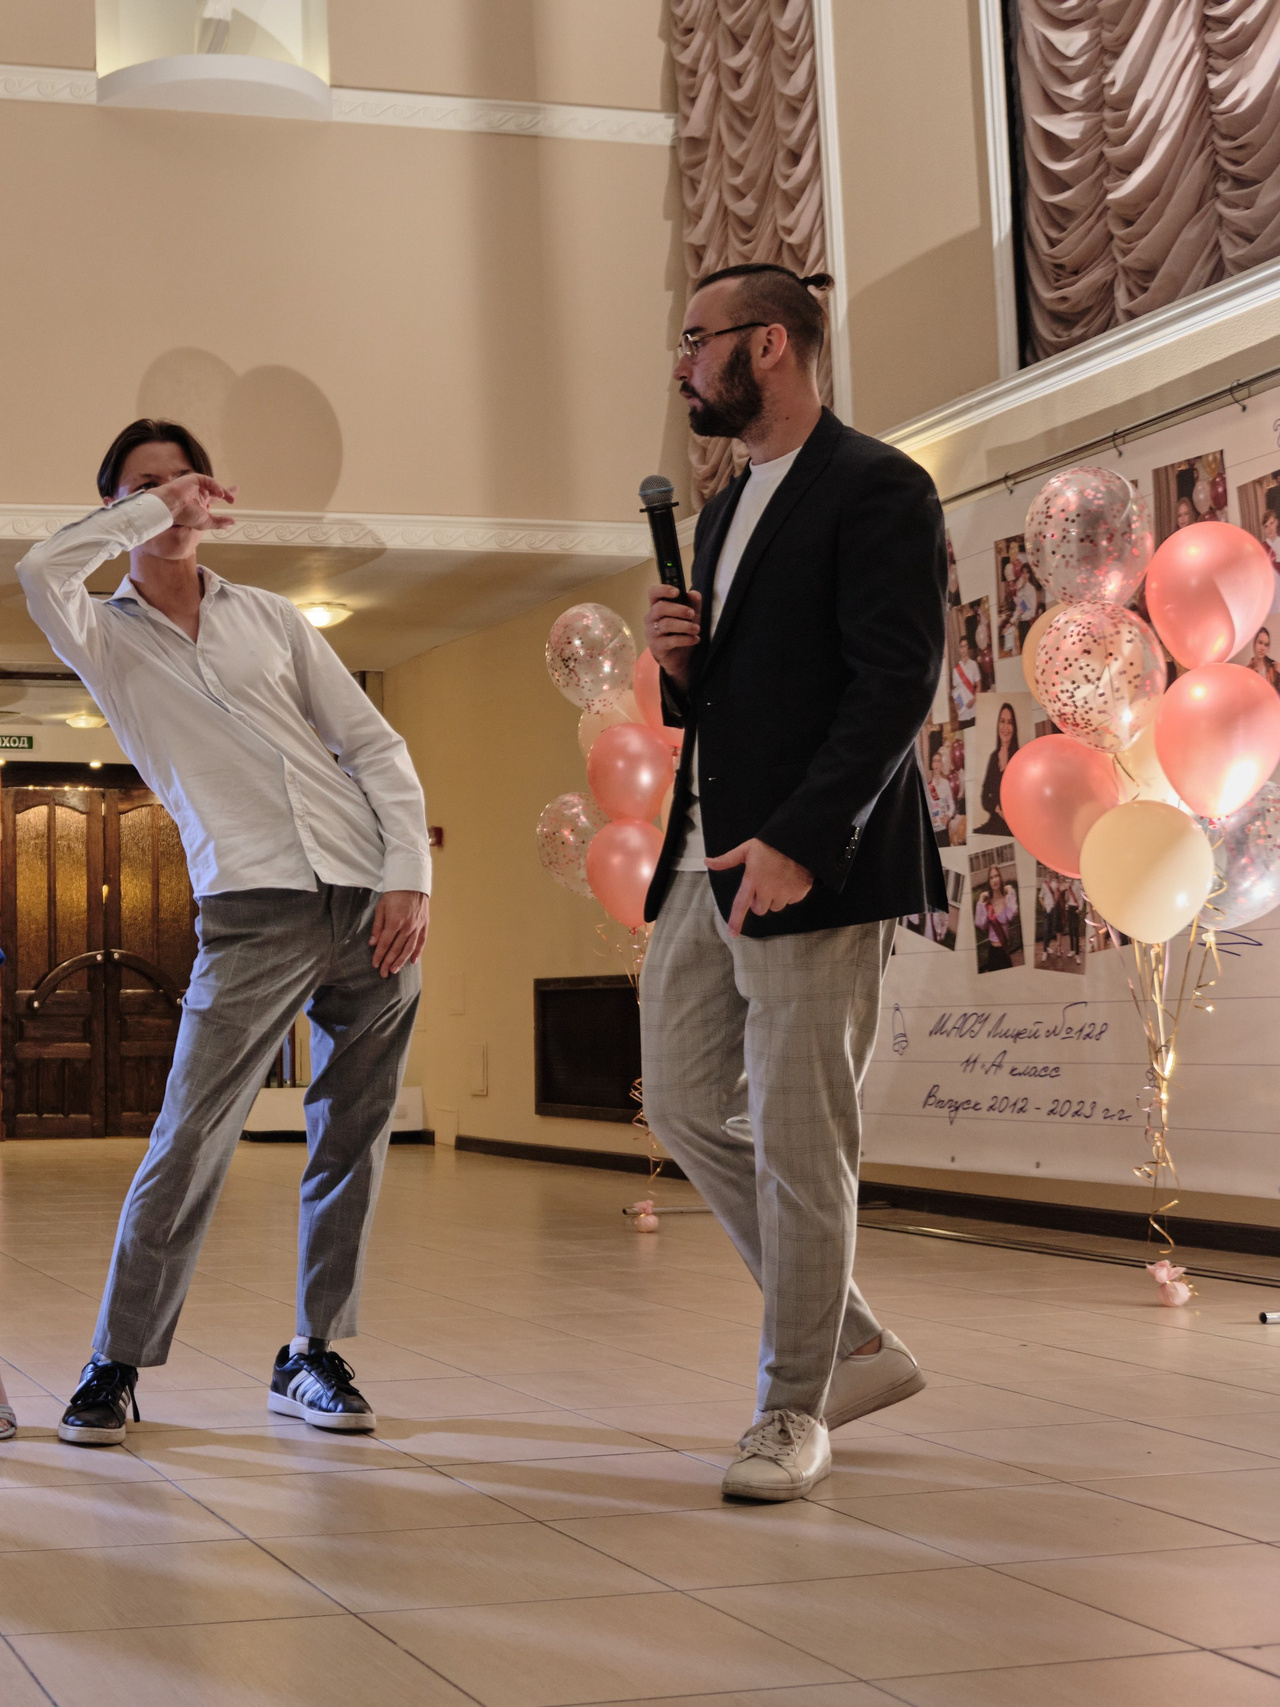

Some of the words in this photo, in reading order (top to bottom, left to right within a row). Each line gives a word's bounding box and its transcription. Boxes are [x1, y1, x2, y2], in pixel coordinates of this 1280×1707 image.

[929, 1012, 992, 1039] МАОУ
[987, 1012, 1044, 1044] Лицей
[960, 1053, 981, 1074] 11
[1009, 1065, 1062, 1079] класс
[922, 1084, 982, 1126] Выпуск
[986, 1095, 1029, 1114] 2012
[1047, 1099, 1097, 1119] 2023
